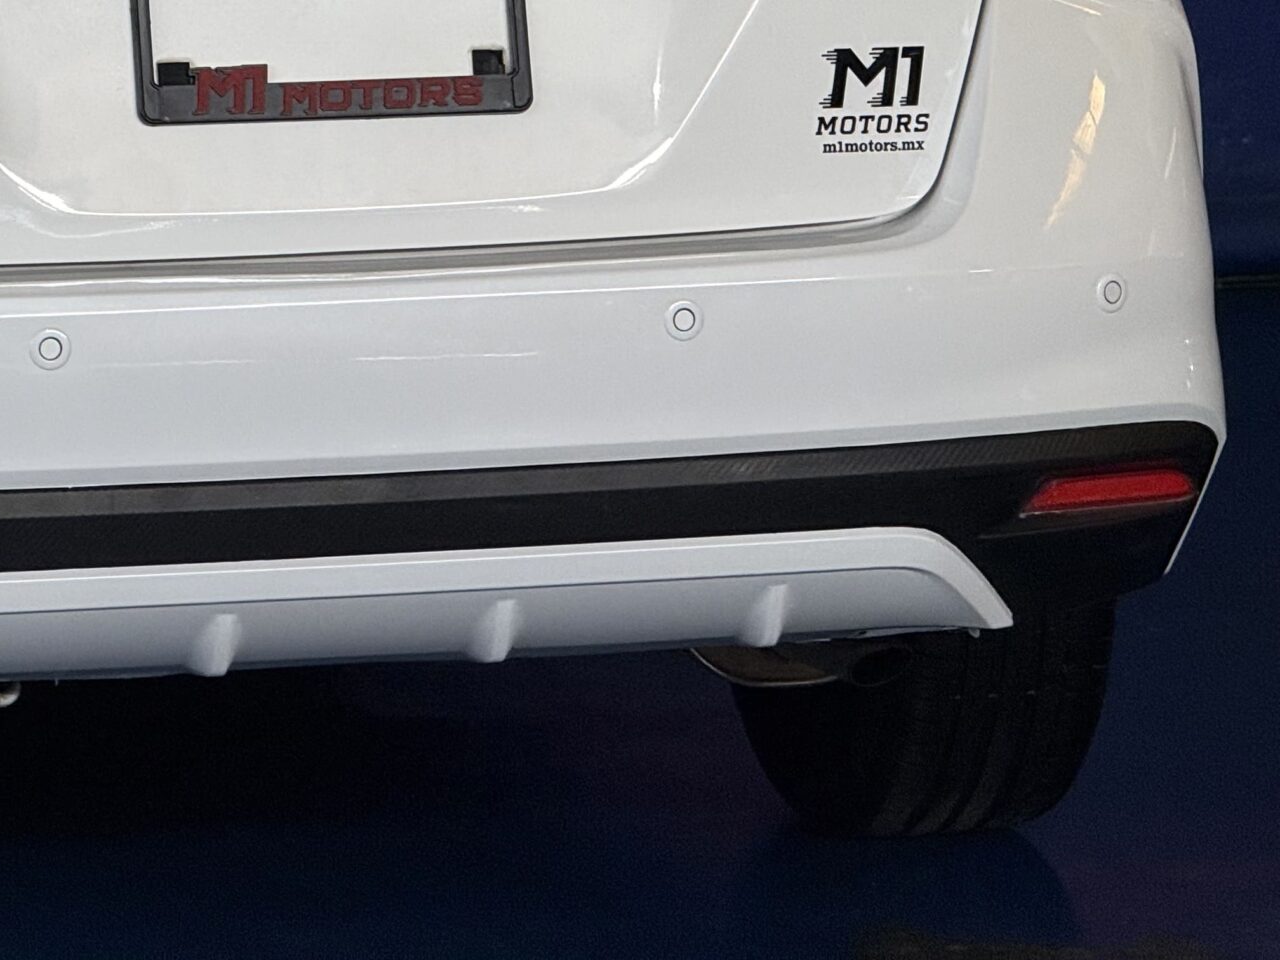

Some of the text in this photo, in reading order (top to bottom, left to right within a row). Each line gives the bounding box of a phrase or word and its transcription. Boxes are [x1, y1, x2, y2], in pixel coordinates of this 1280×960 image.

[192, 64, 485, 116] M1 MOTORS
[818, 45, 925, 108] M1
[815, 113, 930, 136] MOTORS
[822, 139, 925, 154] m1motors.mx
